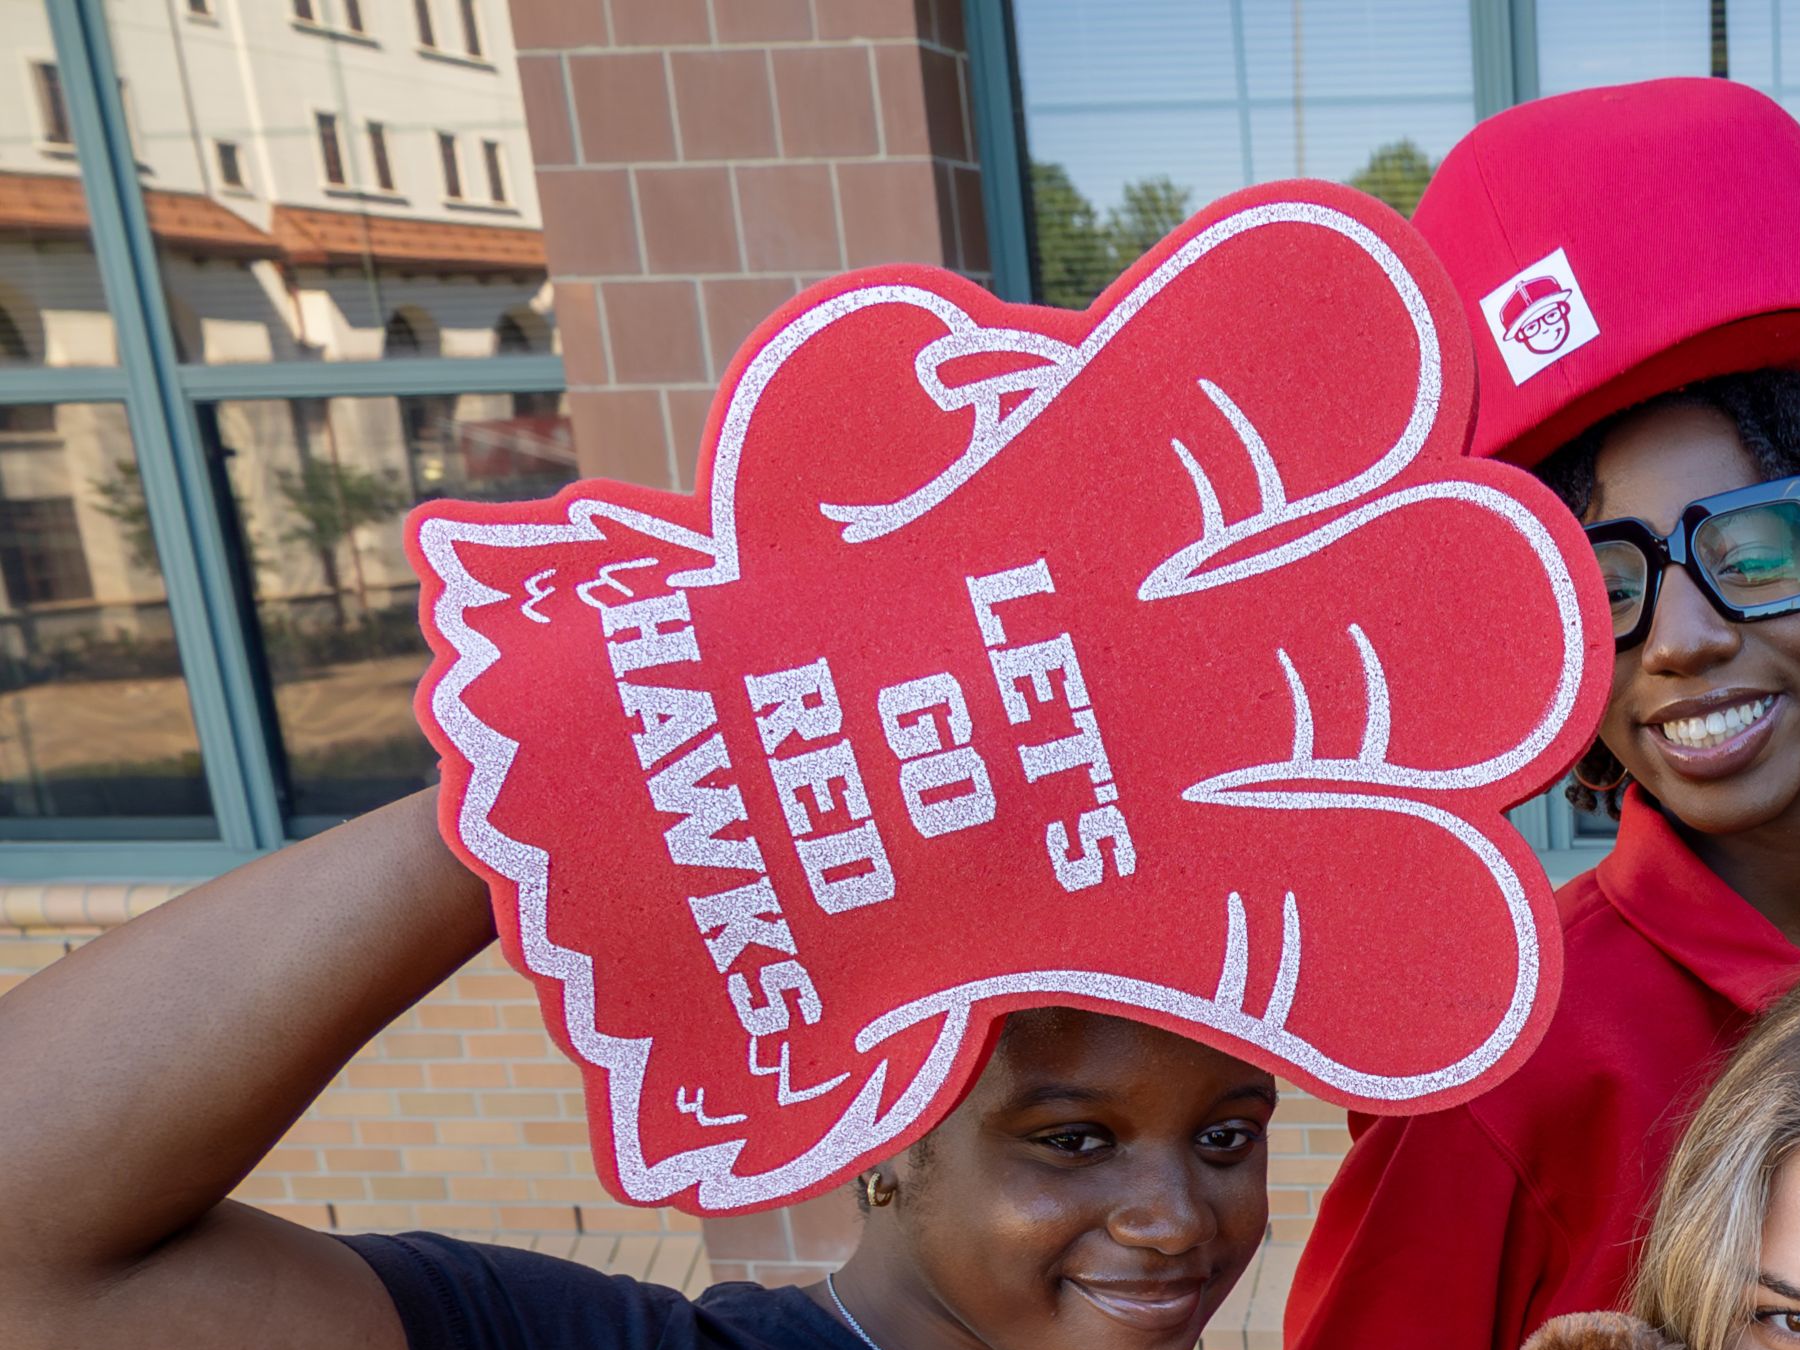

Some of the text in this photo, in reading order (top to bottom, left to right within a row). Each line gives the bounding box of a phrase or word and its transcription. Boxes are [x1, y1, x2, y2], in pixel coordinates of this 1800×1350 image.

[600, 589, 824, 1037] HAWKS
[743, 656, 896, 916] RED
[877, 671, 998, 839] GO
[965, 557, 1137, 893] LET'S
